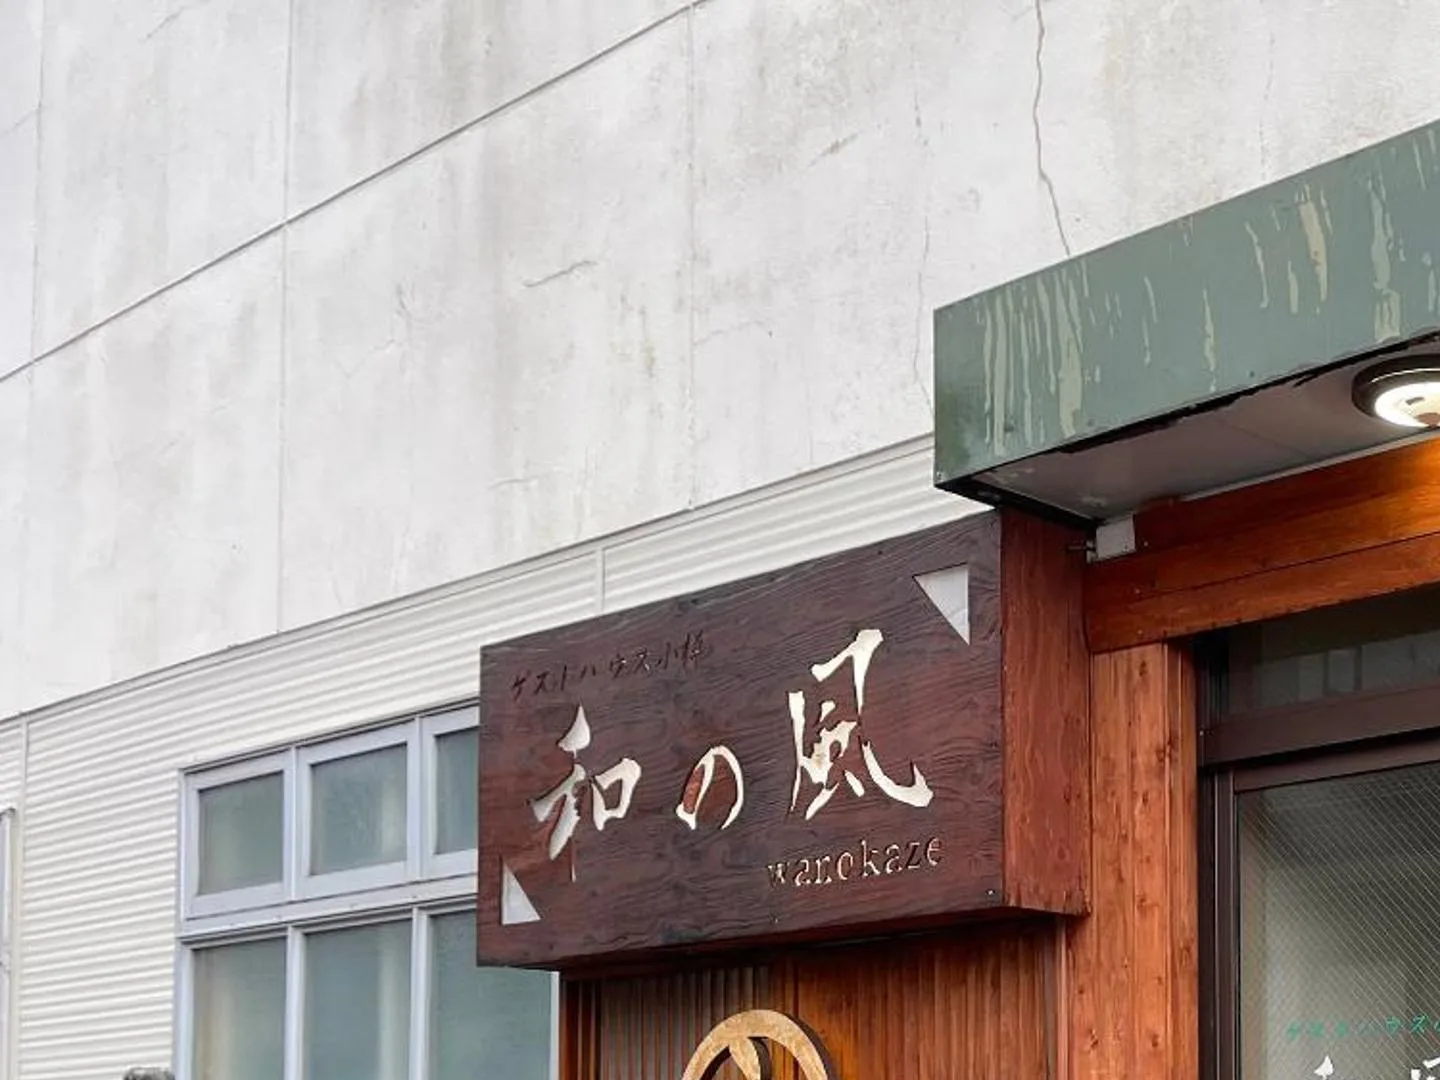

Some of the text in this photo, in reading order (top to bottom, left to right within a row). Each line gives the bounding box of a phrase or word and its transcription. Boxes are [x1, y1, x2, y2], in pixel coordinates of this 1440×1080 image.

[529, 628, 934, 881] 和の風
[766, 835, 943, 888] wanokaze
